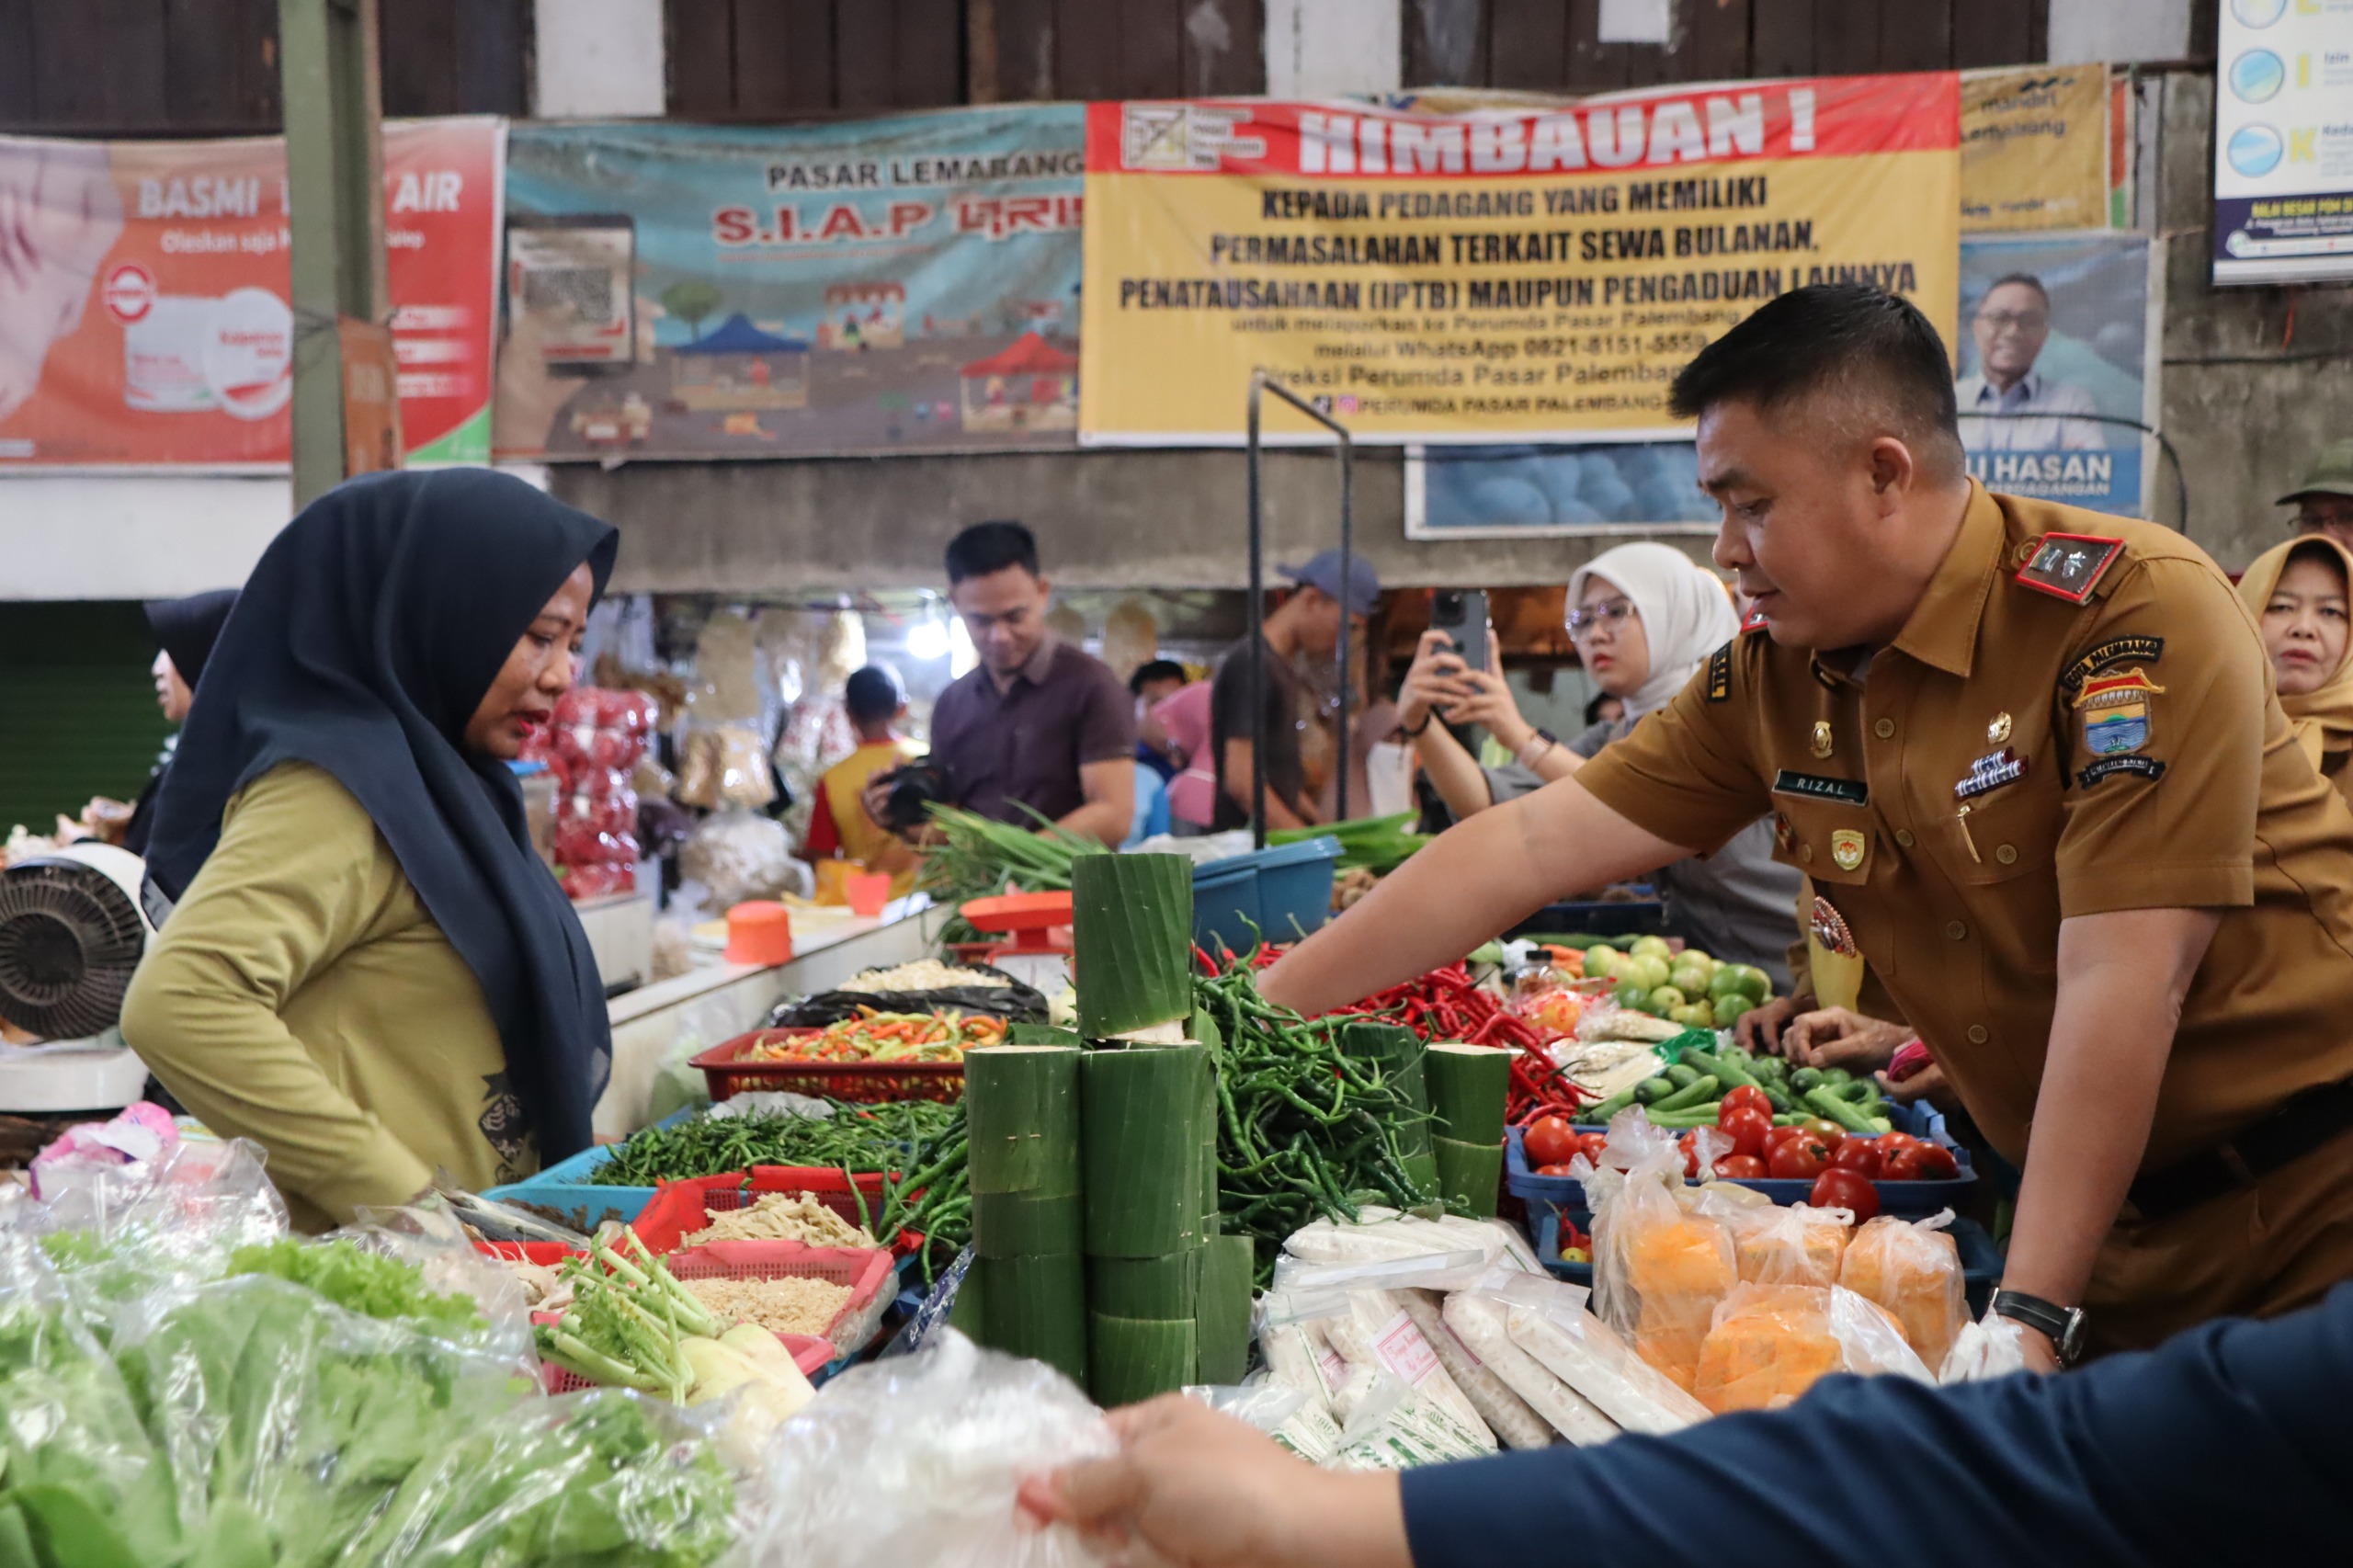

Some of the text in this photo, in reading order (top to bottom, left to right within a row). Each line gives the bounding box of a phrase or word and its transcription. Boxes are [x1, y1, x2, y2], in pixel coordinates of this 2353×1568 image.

[1299, 87, 1815, 174] HIMBAUAN !
[768, 152, 1083, 189] PASAR LEMABANG
[139, 176, 259, 218] BASMI
[392, 171, 463, 212] AIR
[1262, 175, 1768, 220] KEPADA PEDAGANG YANG MEMILIKI
[714, 203, 932, 244] S.I.A.P
[1211, 219, 1820, 265] PERMASALAHAN TERKAIT SEWA BULANAN.
[1120, 278, 1360, 311] PENATAUSAHAAN
[1370, 280, 1459, 311] (IPTB)
[1469, 276, 1593, 310] MAUPUN
[1603, 268, 1781, 306] PENGADUAN
[1453, 313, 1547, 330] Perumda
[1554, 312, 1613, 328] Pasar
[1621, 307, 1741, 328] Palembang
[1395, 337, 1518, 359] WhatsApp
[1349, 365, 1464, 386] Perumda
[1472, 364, 1546, 385] Pasar
[1358, 399, 1456, 414] PERUMDA
[1462, 397, 1529, 413] PASAR
[1994, 454, 2111, 482] HASAN
[1797, 778, 1844, 794] RIZAL
